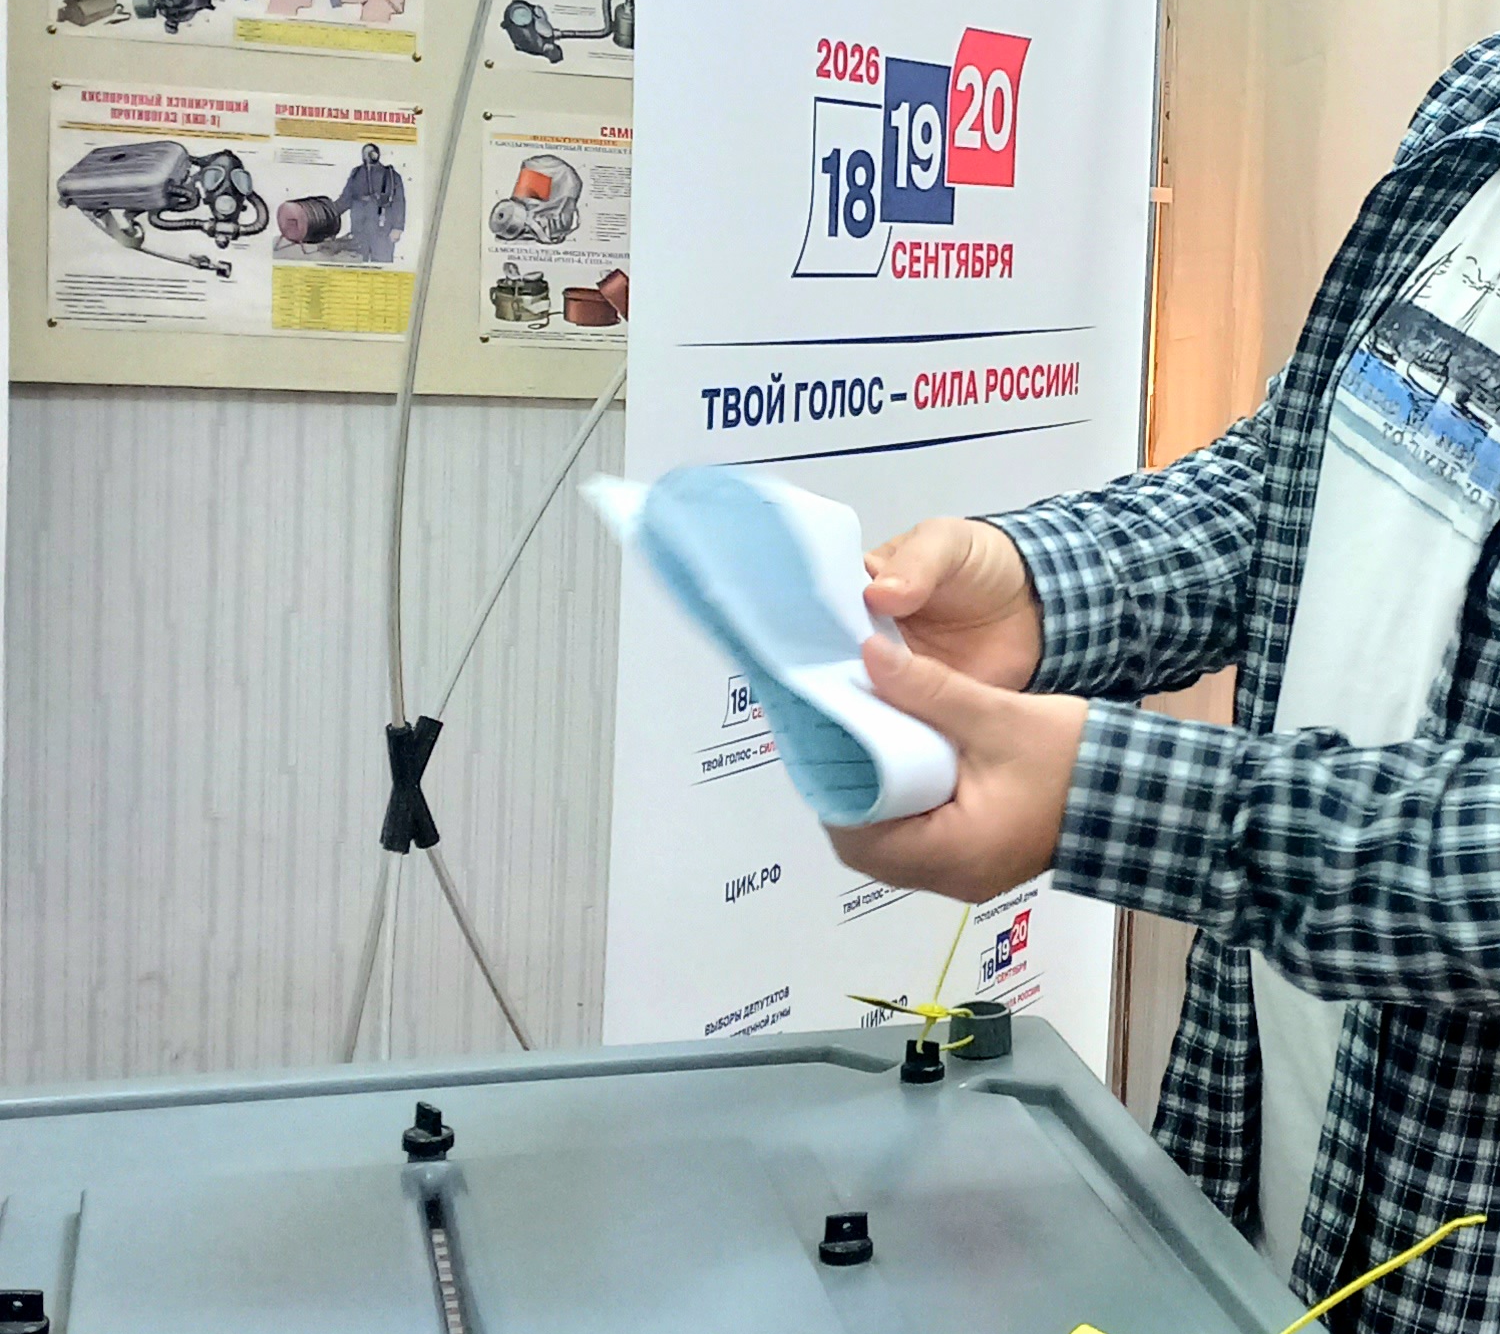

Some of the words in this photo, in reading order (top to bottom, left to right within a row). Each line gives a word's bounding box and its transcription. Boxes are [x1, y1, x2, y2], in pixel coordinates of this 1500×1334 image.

[816, 38, 880, 85] 2026
[275, 103, 350, 119] ПРОТИВОГАЗЫ
[821, 148, 876, 239] 18
[890, 101, 943, 190] 19
[953, 65, 1014, 152] 20
[890, 240, 1014, 279] СЕНТЯБРЯ
[701, 372, 785, 431] ТВОЙ
[794, 376, 884, 422] ГОЛОС
[913, 370, 979, 410] СИЛА
[985, 362, 1080, 402] РОССИИ!
[731, 687, 748, 714] 18
[701, 754, 724, 774] ТВОЙ
[725, 748, 751, 766] ГОЛОС
[725, 863, 782, 904] ЦИК.РФ
[983, 958, 994, 982] 18
[997, 938, 1010, 964] 19
[1011, 920, 1027, 946] 20
[704, 1008, 742, 1037] ВЫБОРЫ
[743, 985, 790, 1020] ДЕПУТАТОВ
